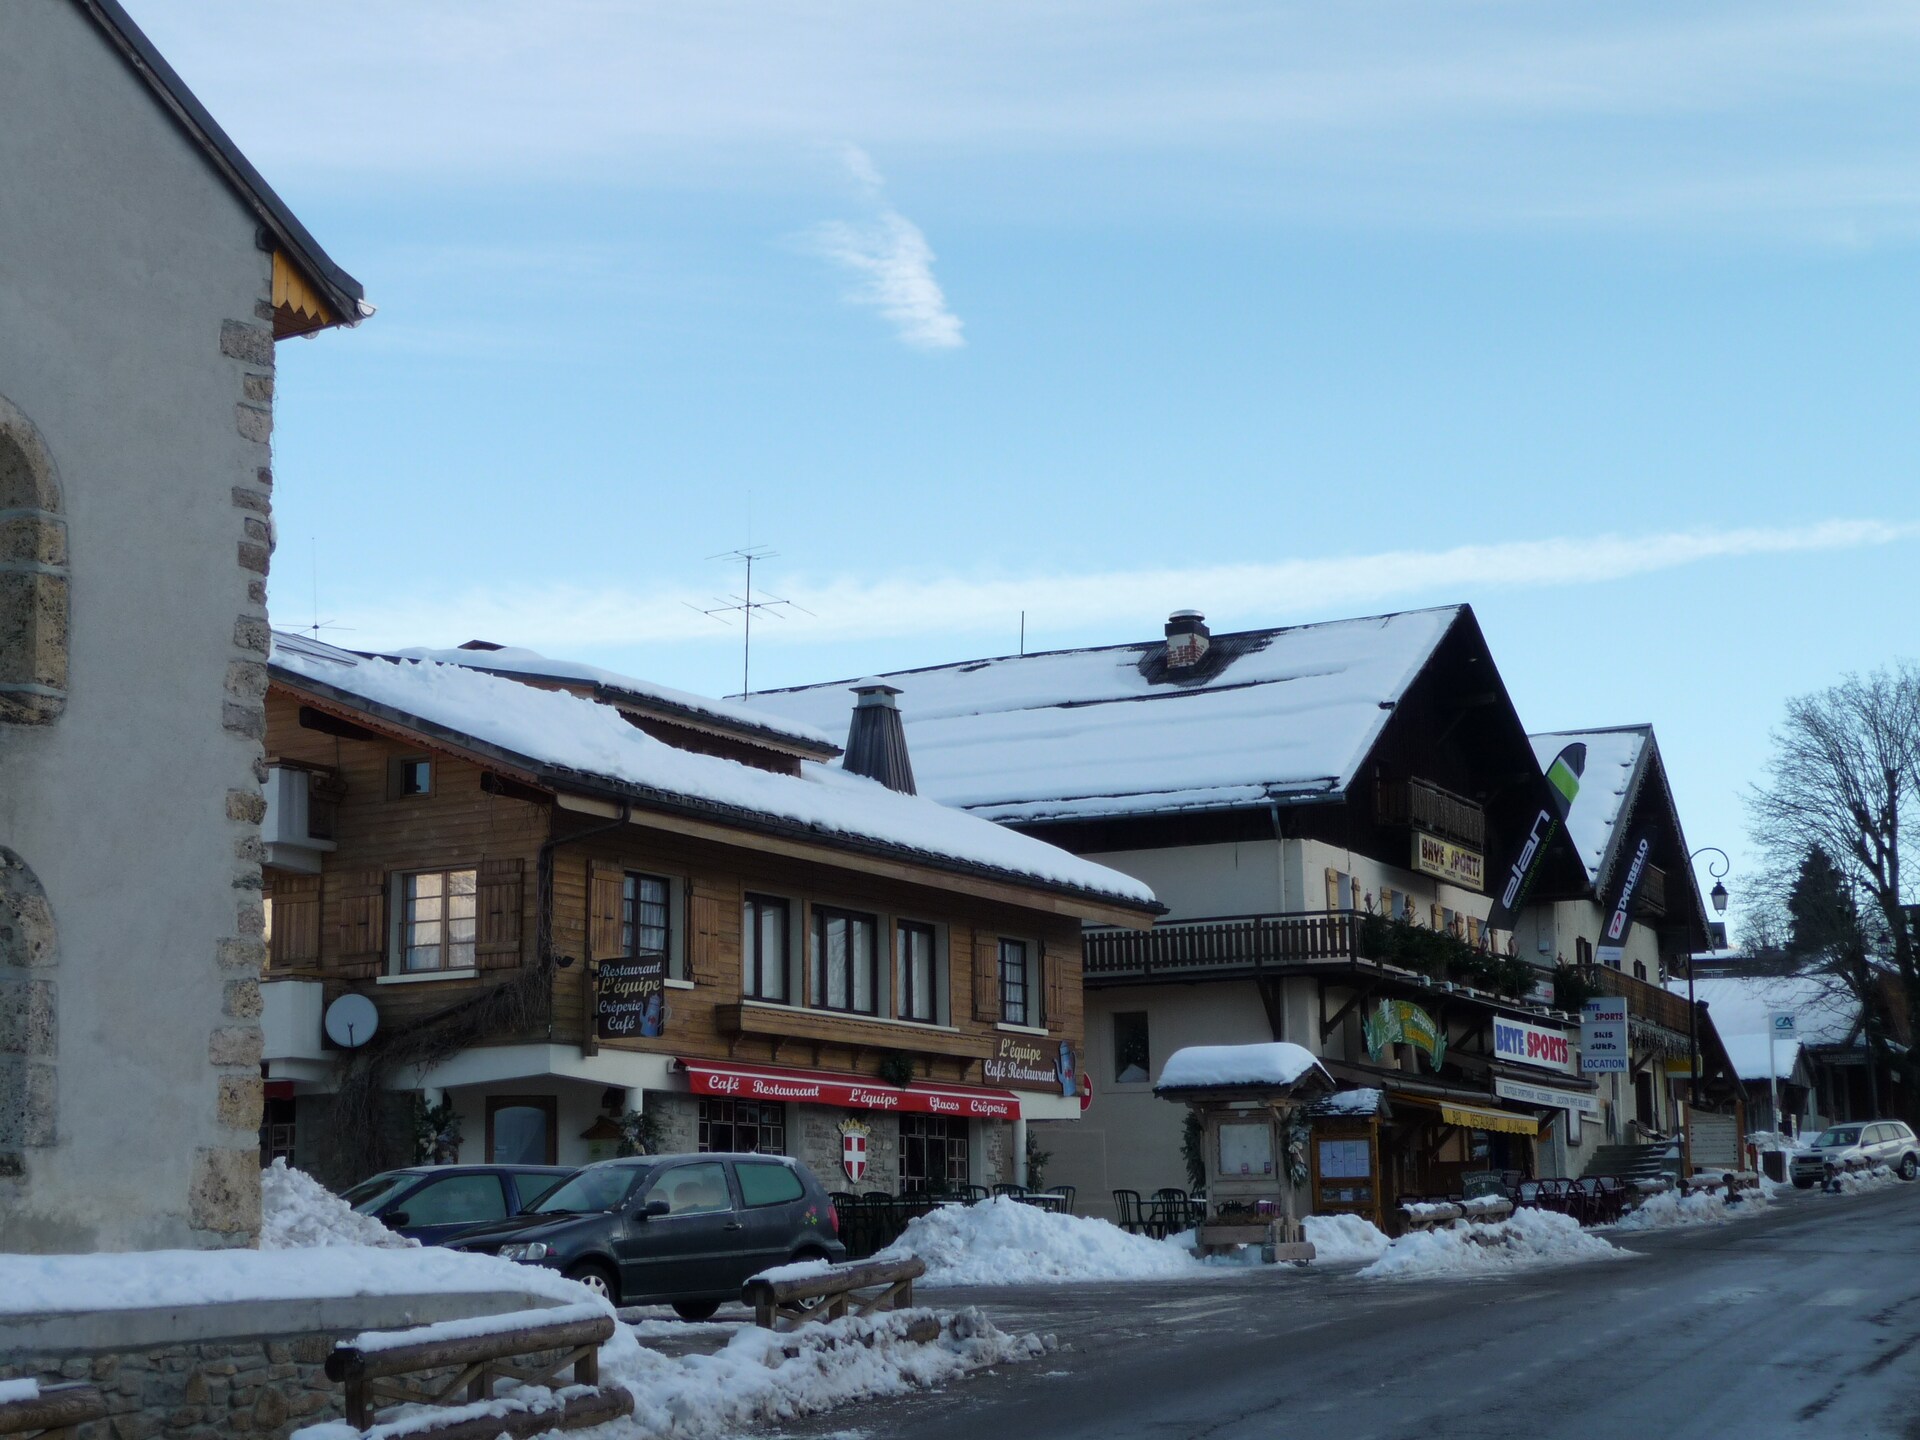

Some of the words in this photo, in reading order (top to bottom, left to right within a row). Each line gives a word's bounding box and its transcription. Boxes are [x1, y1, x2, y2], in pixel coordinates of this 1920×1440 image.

[1422, 838, 1445, 866] BRYE
[1450, 849, 1481, 878] SPORTS
[1502, 809, 1551, 909] elan
[1618, 838, 1648, 911] DALBELLO
[600, 961, 661, 978] Restaurant
[599, 977, 661, 998] L'équipe
[600, 1000, 641, 1016] Crêperie
[1594, 1012, 1623, 1021] SPORTS
[607, 1015, 636, 1034] Café
[1593, 1031, 1614, 1039] SKIS
[999, 1038, 1042, 1066] L'équipe
[1495, 1023, 1525, 1056] BRYE
[1526, 1031, 1569, 1064] SPORTS
[984, 1059, 1006, 1082] Café
[1007, 1061, 1056, 1083] Restaurant
[1583, 1059, 1625, 1069] LOCATION
[708, 1075, 740, 1094] Café
[752, 1079, 820, 1097] Restaurant
[848, 1088, 898, 1109] L'équipe
[929, 1096, 960, 1111] Glaces
[970, 1099, 1008, 1116] Crêperie
[1470, 1113, 1498, 1129] RESTAURANT
